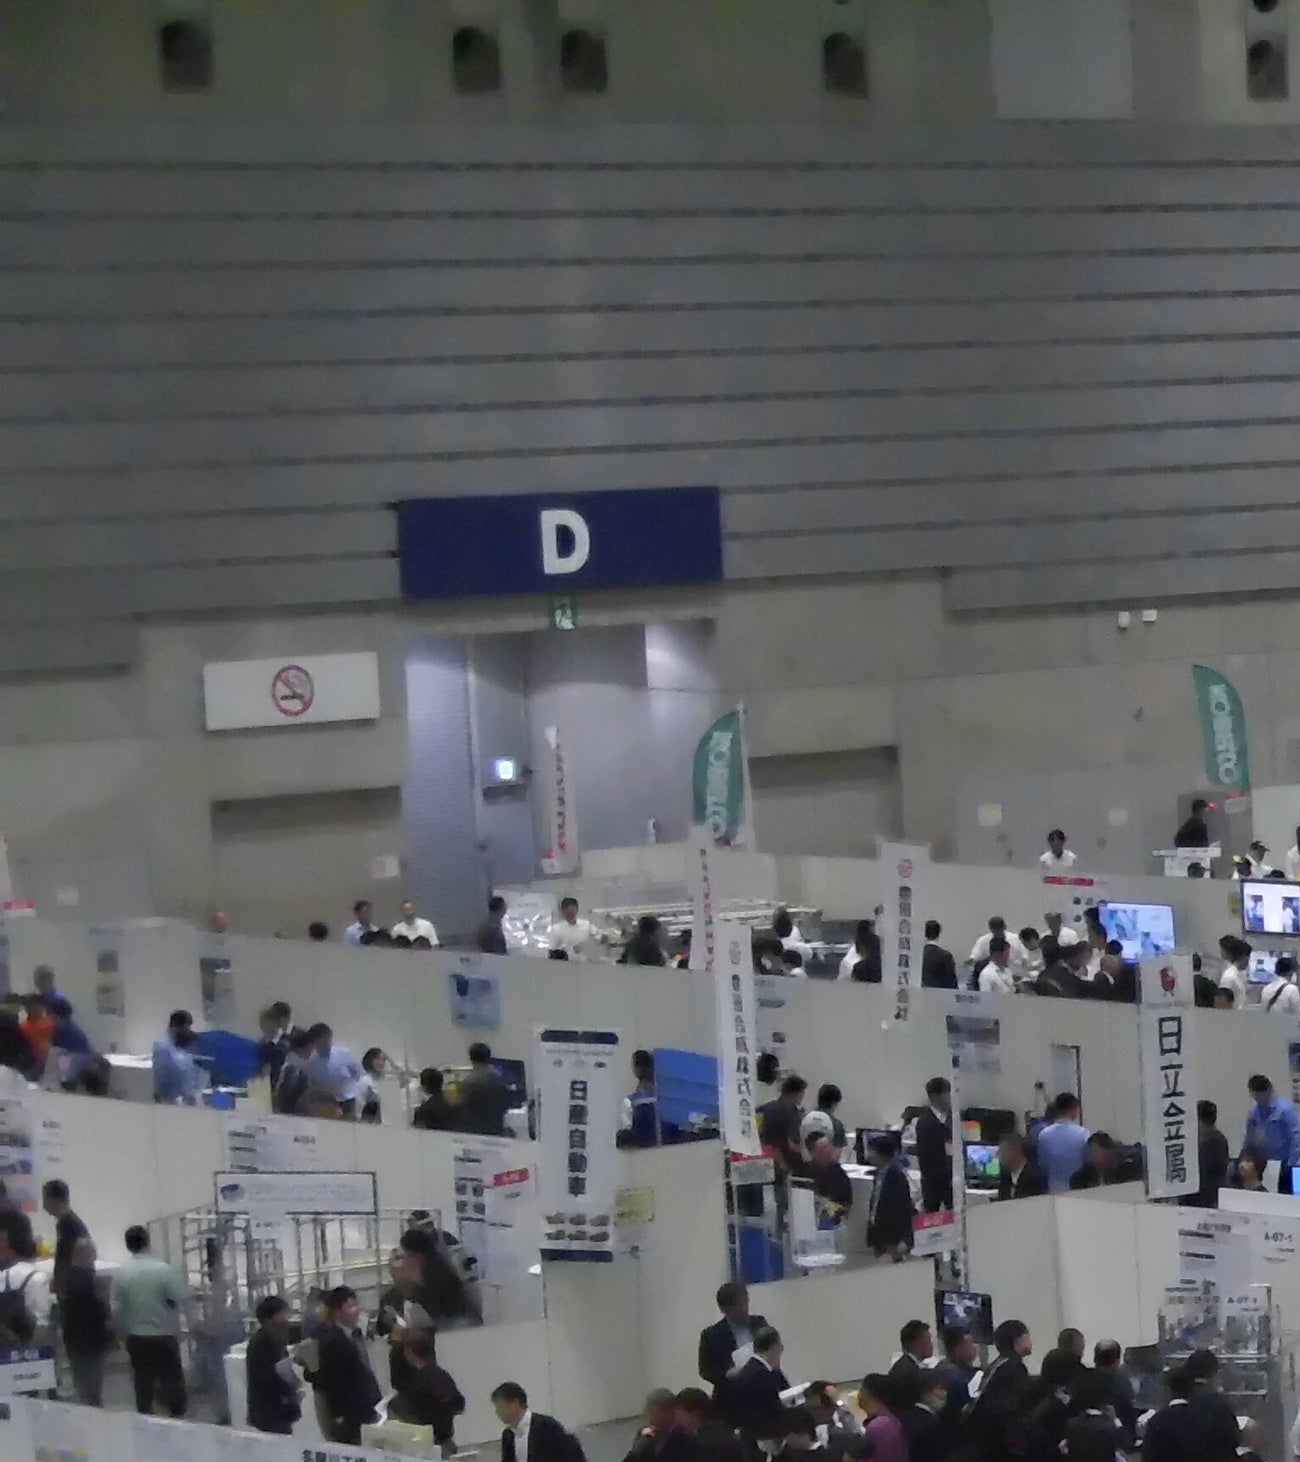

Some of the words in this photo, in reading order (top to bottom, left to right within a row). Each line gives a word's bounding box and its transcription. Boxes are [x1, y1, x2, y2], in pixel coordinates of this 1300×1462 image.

[540, 510, 590, 575] D
[1158, 1016, 1187, 1184] 日立金属
